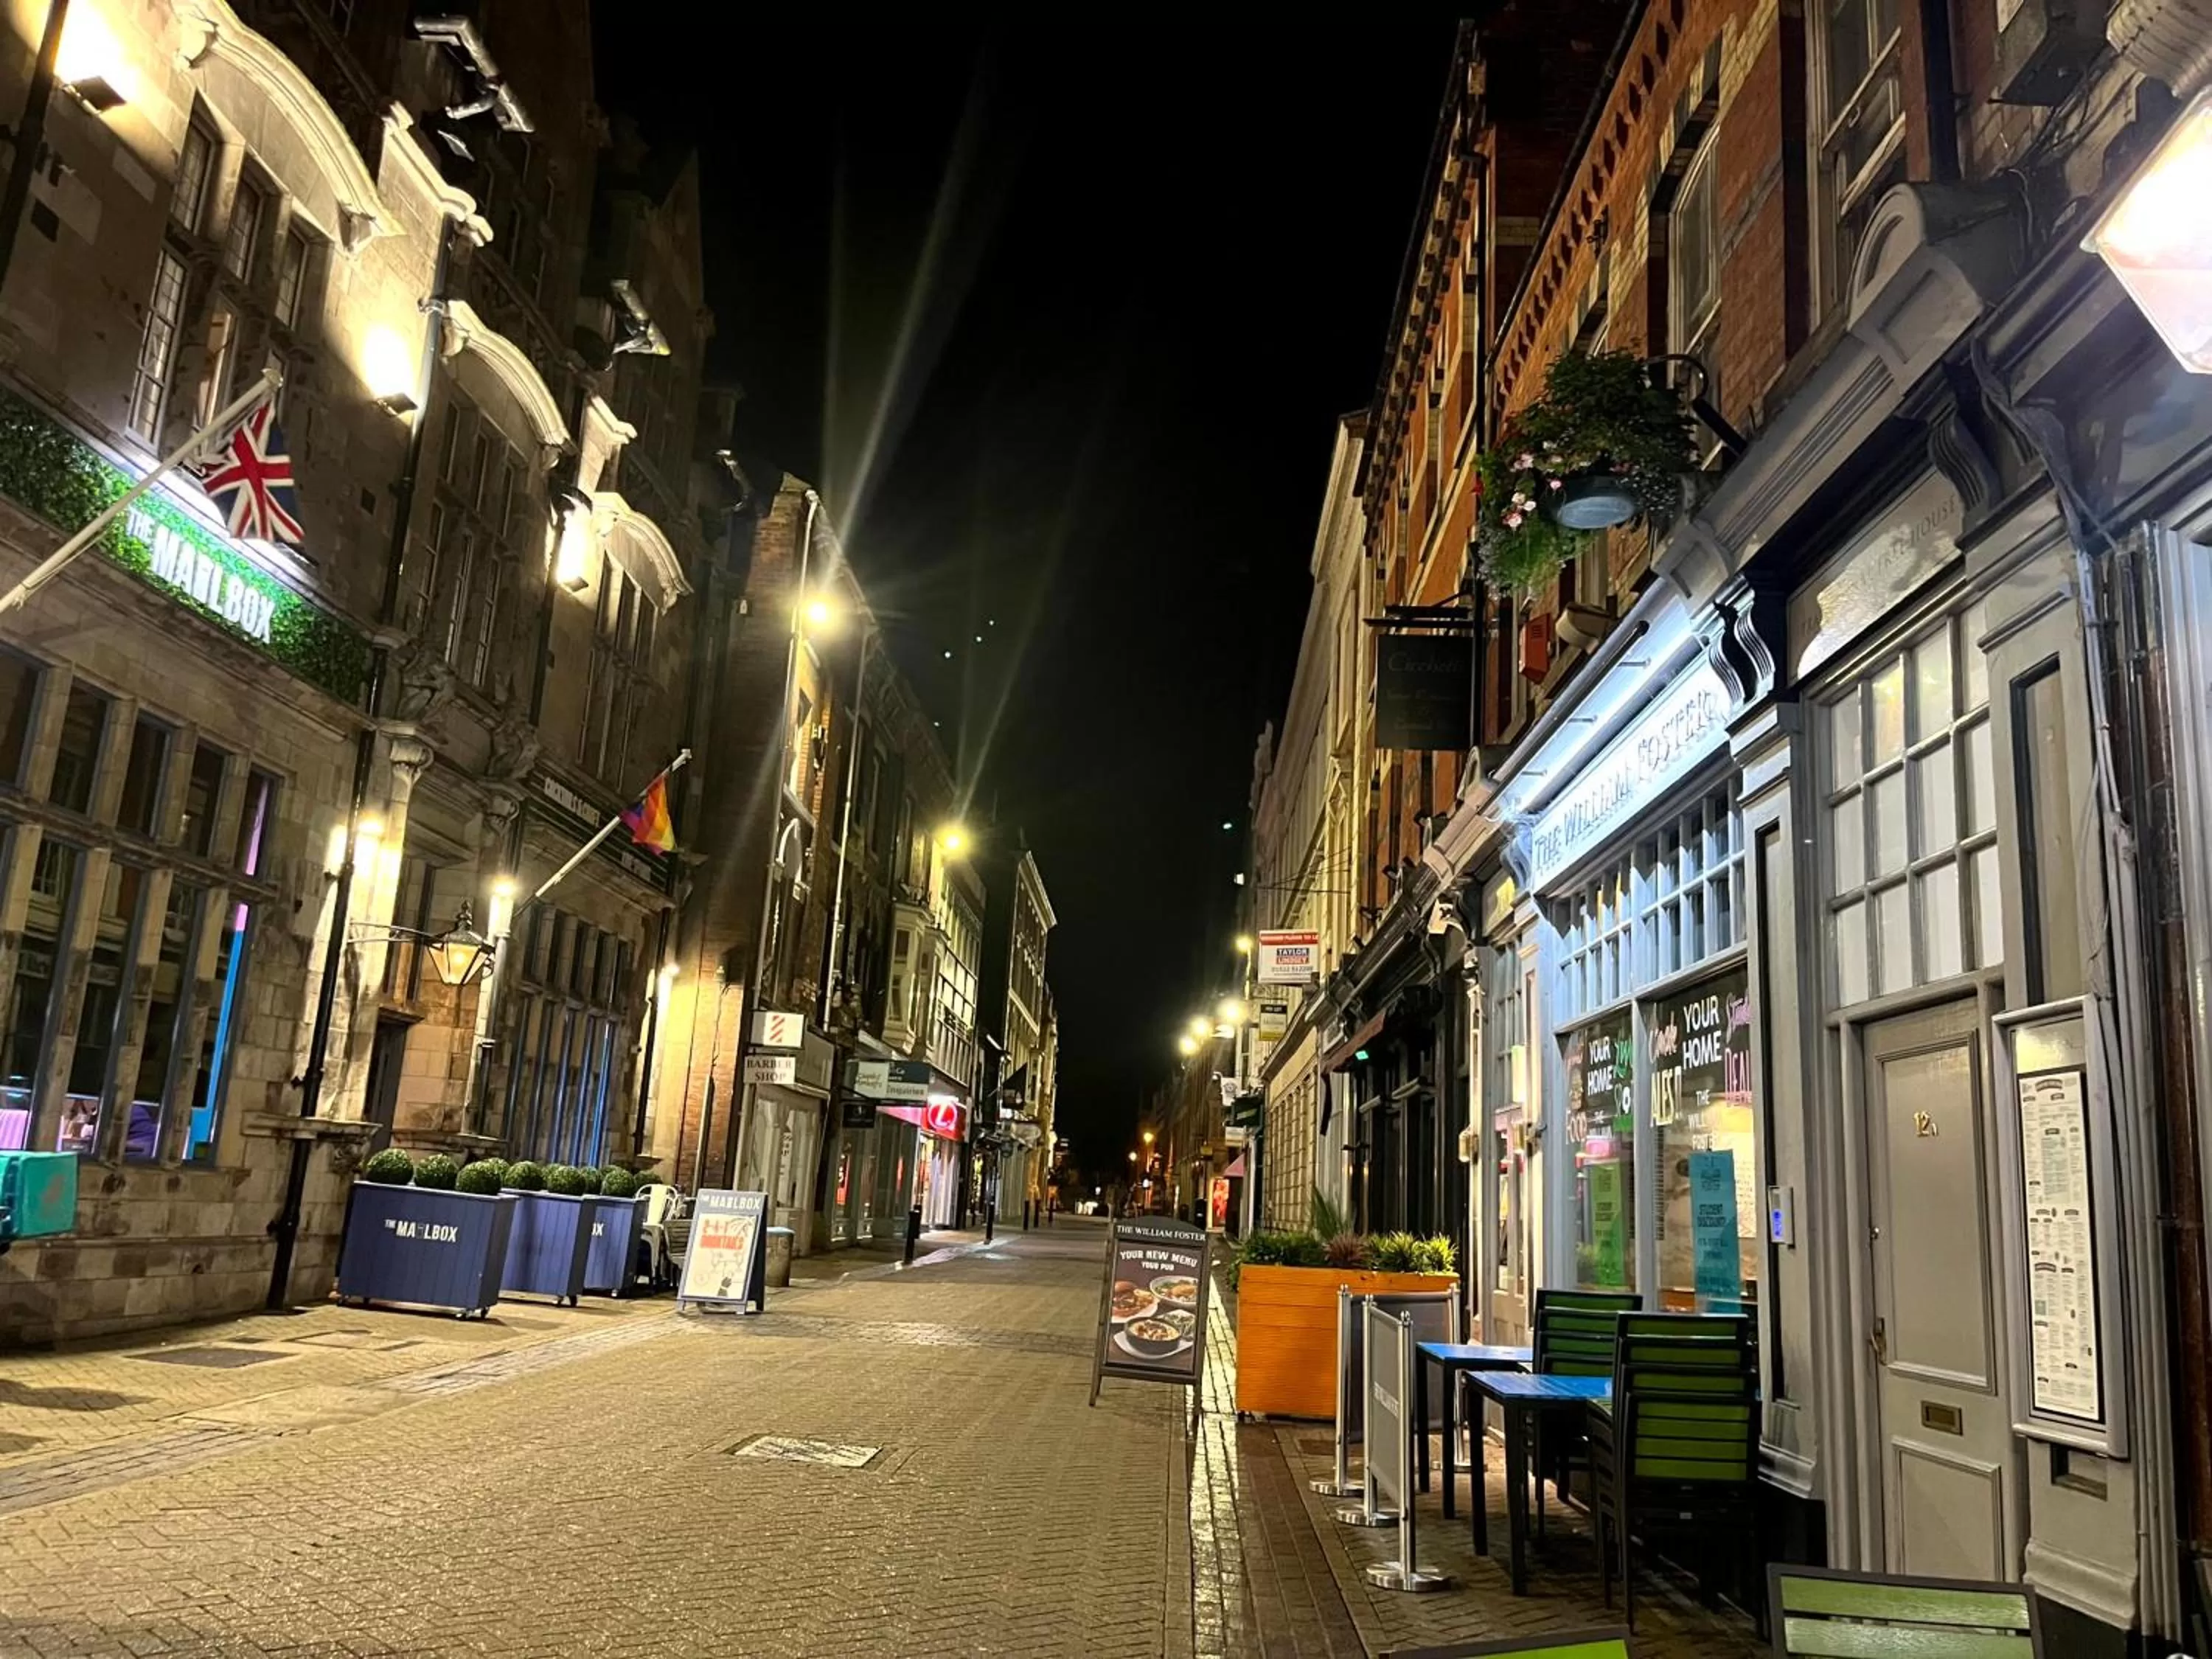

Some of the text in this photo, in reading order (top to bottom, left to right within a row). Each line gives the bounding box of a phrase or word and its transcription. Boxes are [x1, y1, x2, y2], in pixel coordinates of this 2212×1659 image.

[1683, 995, 1720, 1033] YOUR
[1588, 1036, 1611, 1065] YOUR
[1683, 1030, 1722, 1071] HOME
[747, 1059, 792, 1068] BARBER
[755, 1072, 787, 1082] SHOP
[1587, 1065, 1613, 1096] HOME
[1696, 1089, 1711, 1106] THE
[1116, 1225, 1206, 1241] THE WILLIAM FOSTER
[1120, 1250, 1197, 1267] YOUR NEW MENU
